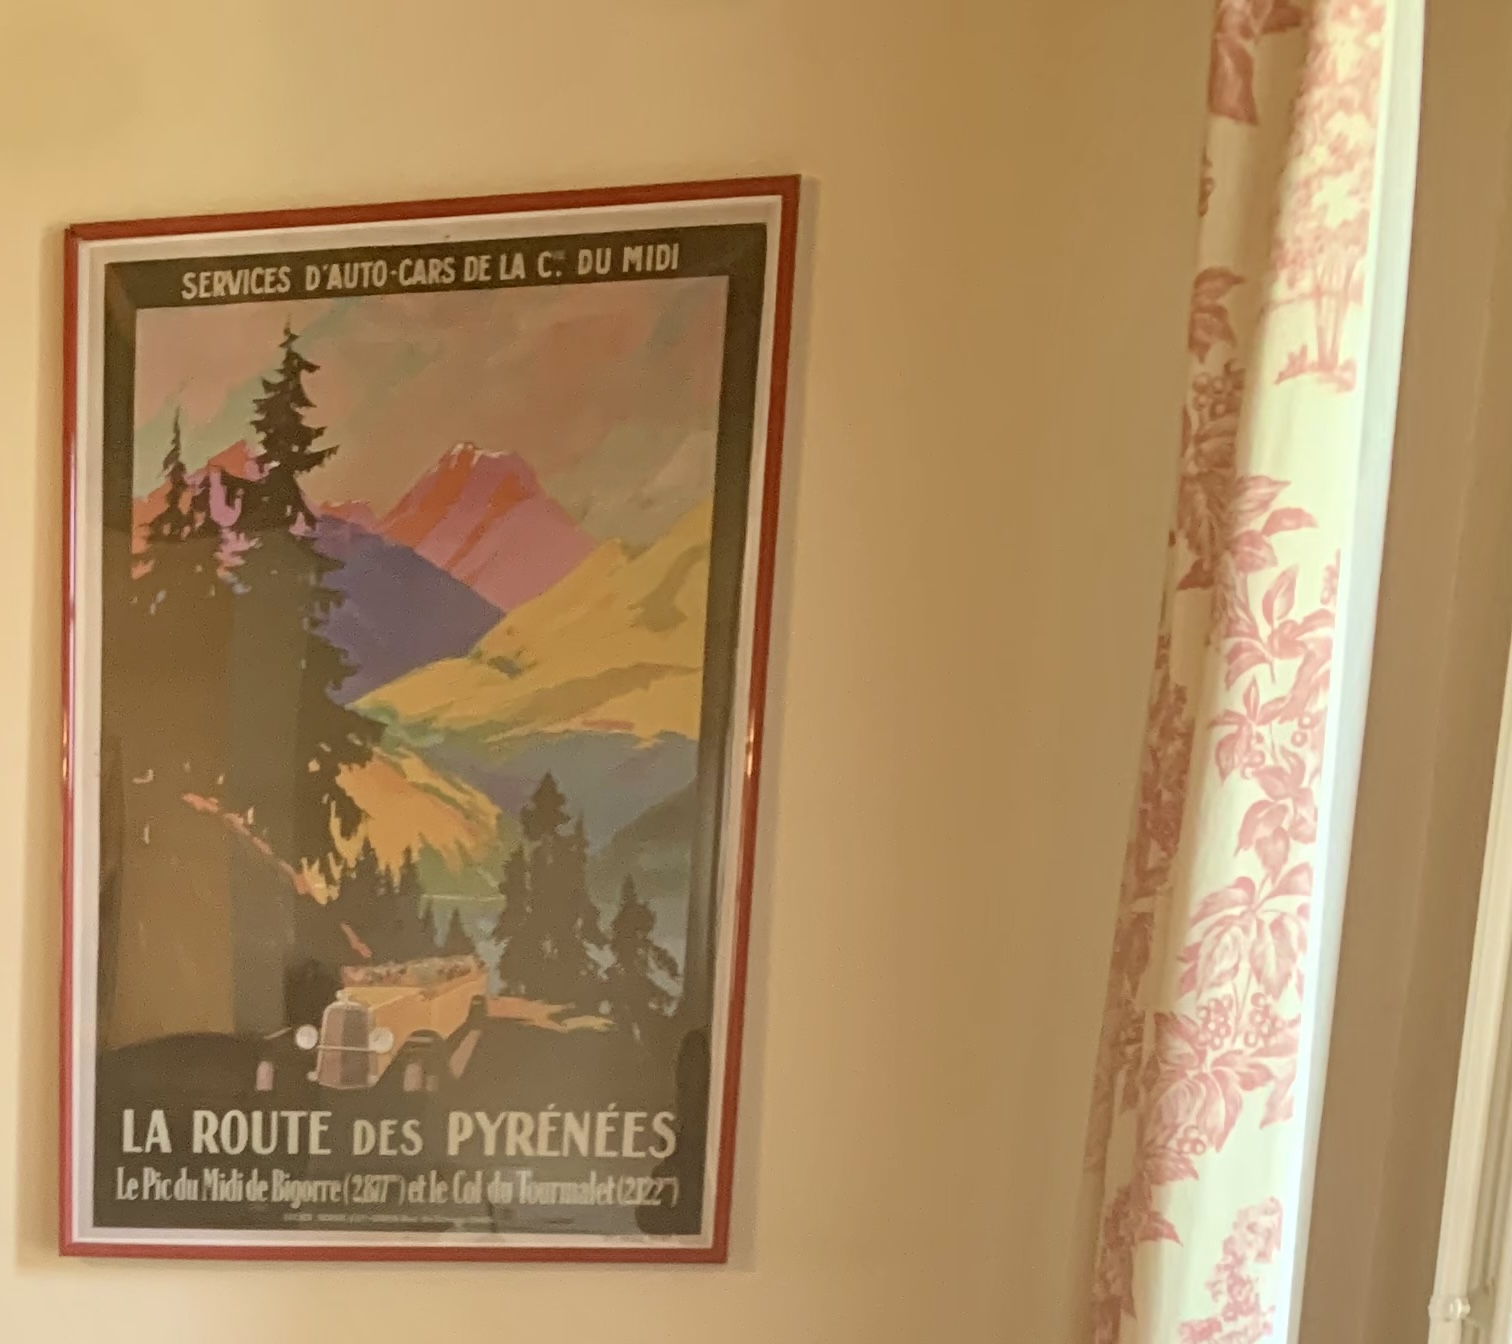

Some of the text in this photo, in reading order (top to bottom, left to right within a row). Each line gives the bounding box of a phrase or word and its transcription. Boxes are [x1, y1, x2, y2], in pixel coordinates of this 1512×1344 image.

[181, 265, 292, 300] SERVICES
[463, 255, 492, 283] DE
[499, 252, 526, 281] LA
[578, 247, 612, 276] DU
[622, 243, 680, 273] MIDI
[122, 1102, 677, 1160] LA ROUTE DES PYRÉNÉES
[116, 1166, 140, 1201] Le
[142, 1166, 173, 1201] Pic
[173, 1166, 199, 1201] du
[202, 1167, 243, 1202] Midi
[245, 1168, 269, 1202] de
[271, 1168, 342, 1209] Bigorre
[408, 1176, 426, 1205] et
[429, 1169, 449, 1204] le
[452, 1170, 483, 1205] Col
[516, 1169, 617, 1206] Tourmalet
